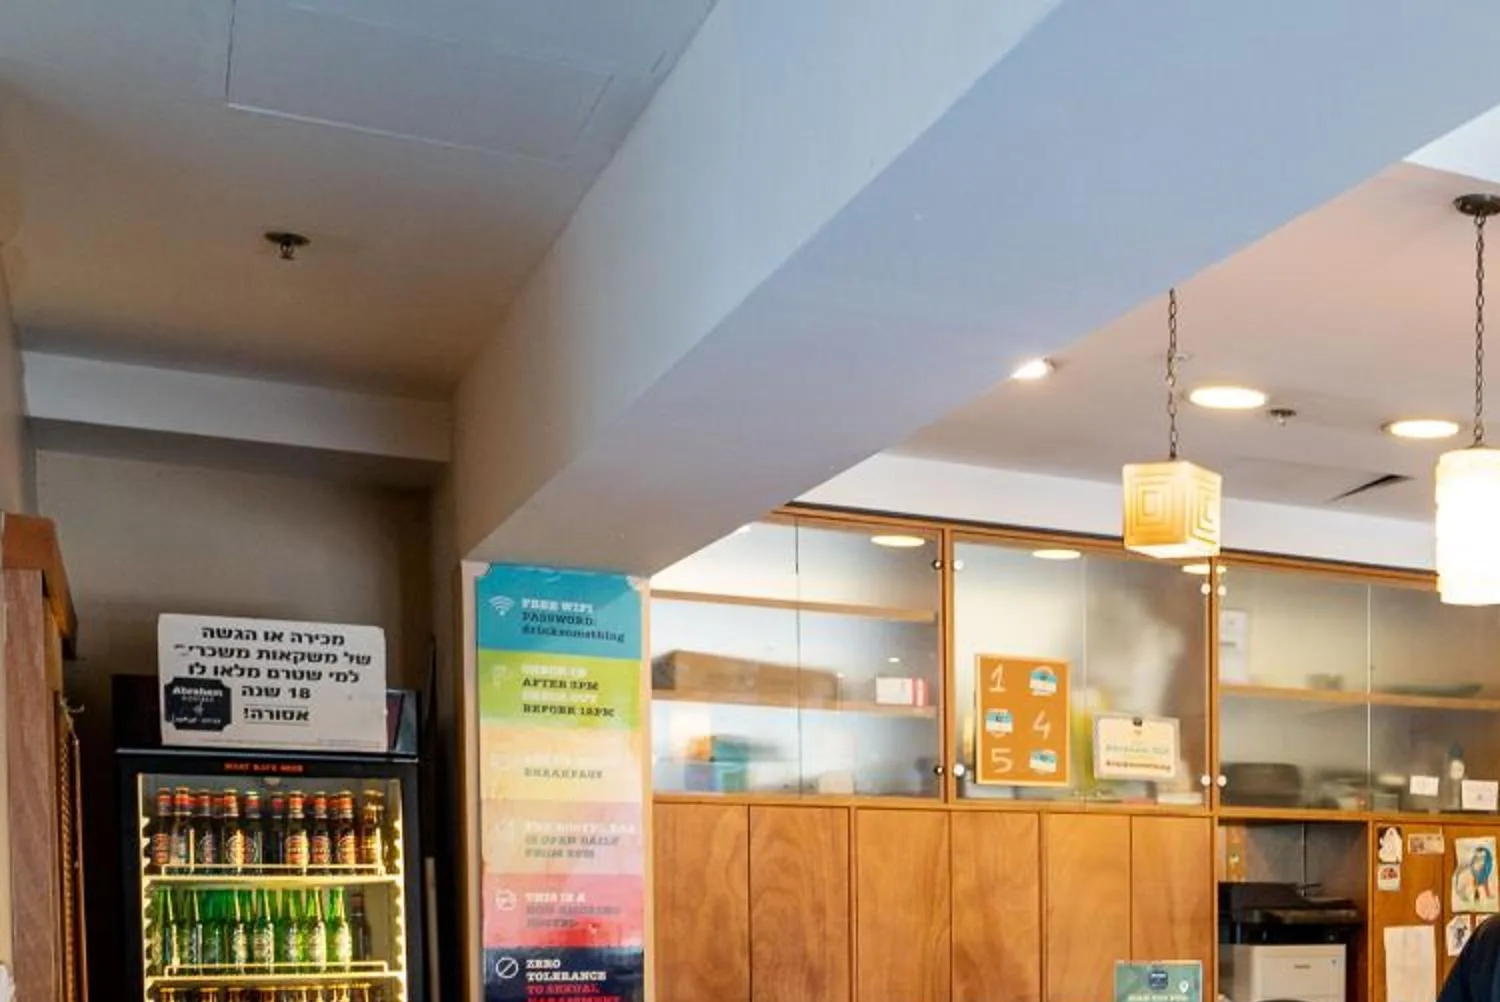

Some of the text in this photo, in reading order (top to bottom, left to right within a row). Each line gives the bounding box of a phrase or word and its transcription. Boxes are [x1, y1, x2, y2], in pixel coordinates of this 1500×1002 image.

[522, 598, 594, 613] FREE WIFI
[202, 627, 345, 646] מכירה או הגשה
[256, 648, 338, 666] משקאות
[343, 651, 371, 666] של
[188, 661, 360, 683] למי שטרם מלאו לו
[988, 664, 1006, 692] 1
[522, 677, 567, 689] AFTER
[241, 685, 311, 699] 18 שנה
[243, 707, 310, 722] אסורה!
[1032, 710, 1051, 741] 4
[991, 748, 1013, 773] 5
[576, 892, 587, 903] A
[525, 959, 561, 969] ZERO
[526, 971, 607, 982] TOLERANCE
[527, 983, 600, 994] TO SEXUAL
